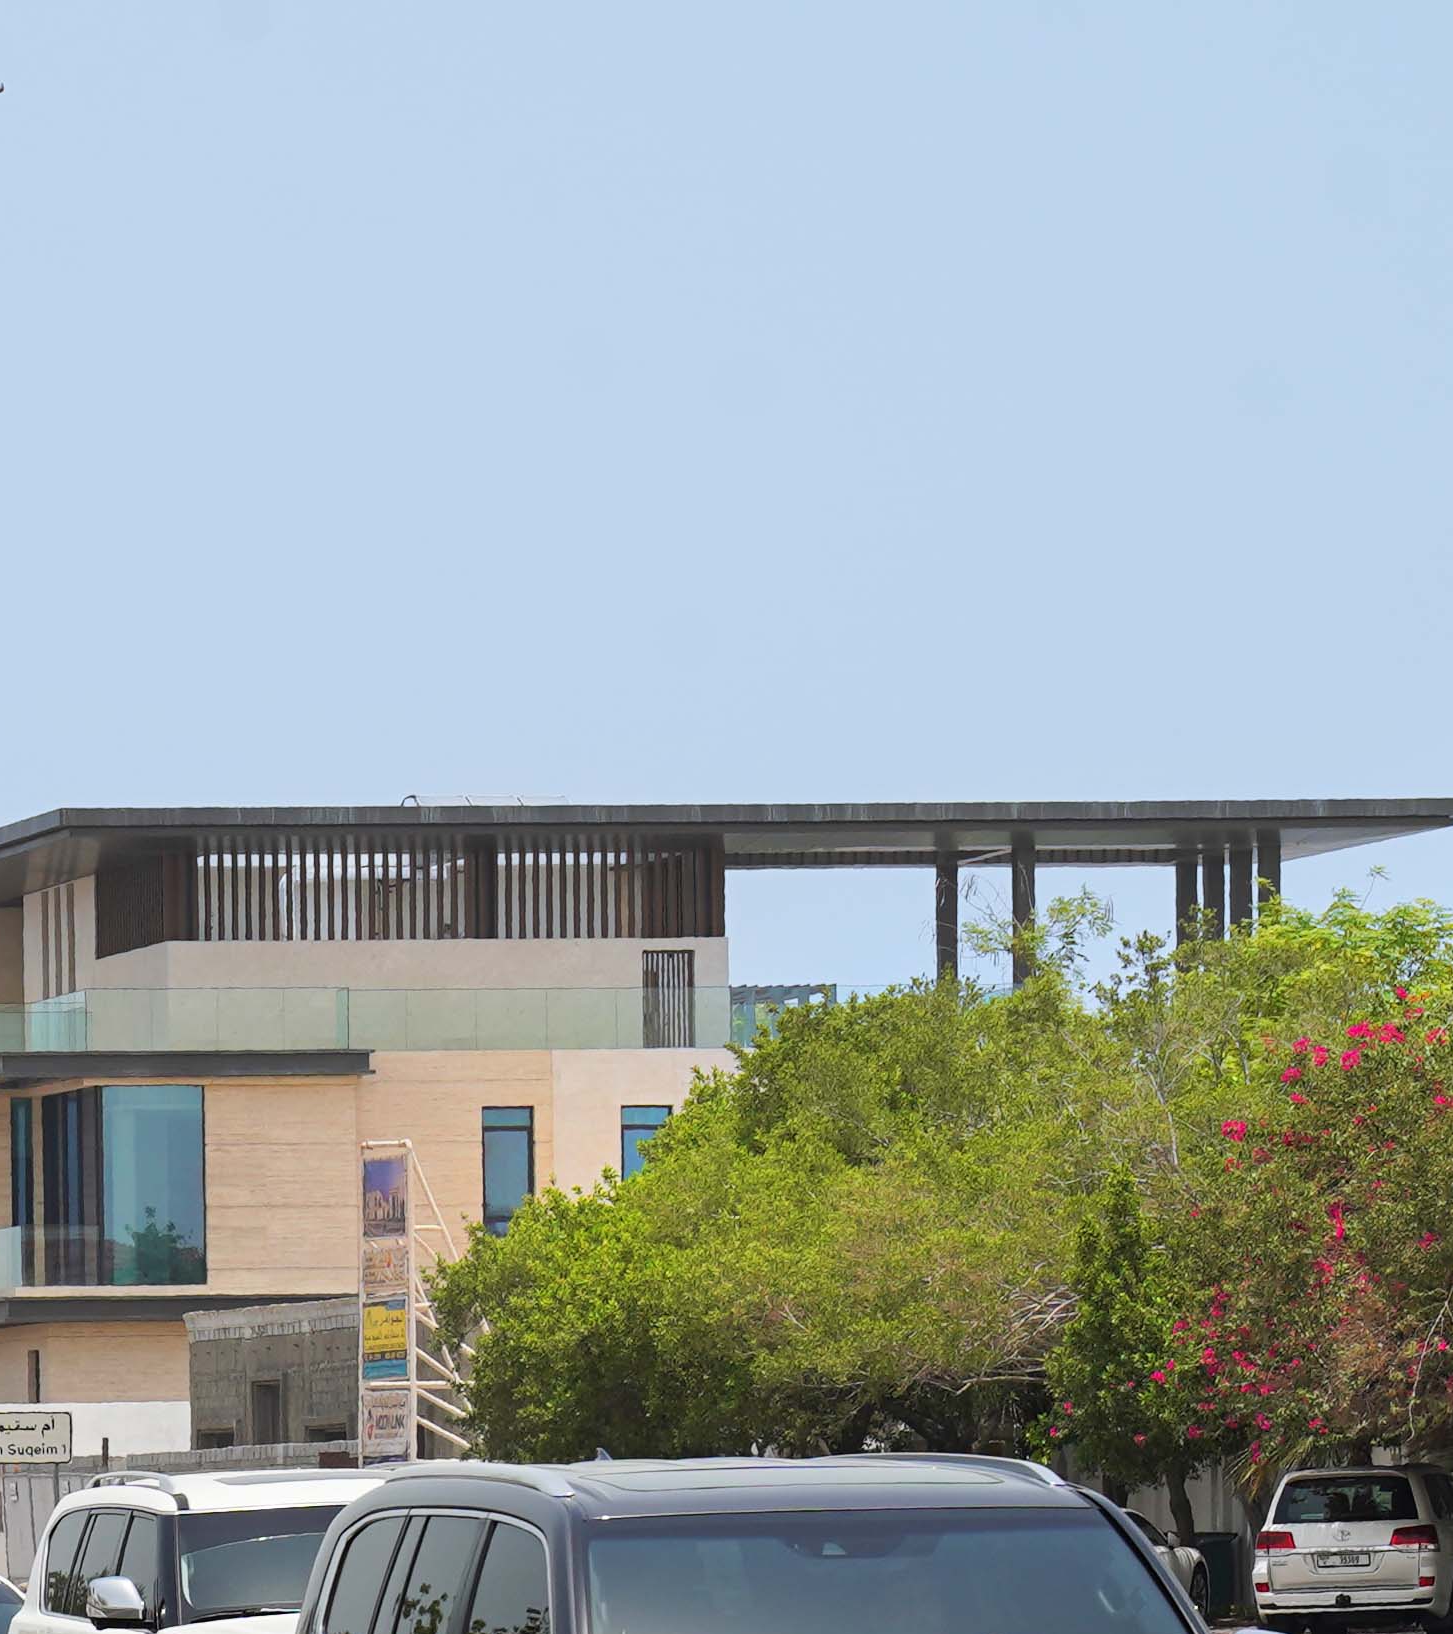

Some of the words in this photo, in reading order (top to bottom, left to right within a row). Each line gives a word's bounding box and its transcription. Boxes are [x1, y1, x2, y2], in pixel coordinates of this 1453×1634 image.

[41, 1415, 55, 1438] أم
[7, 1442, 58, 1457] Suqeim
[62, 1444, 67, 1454] 1
